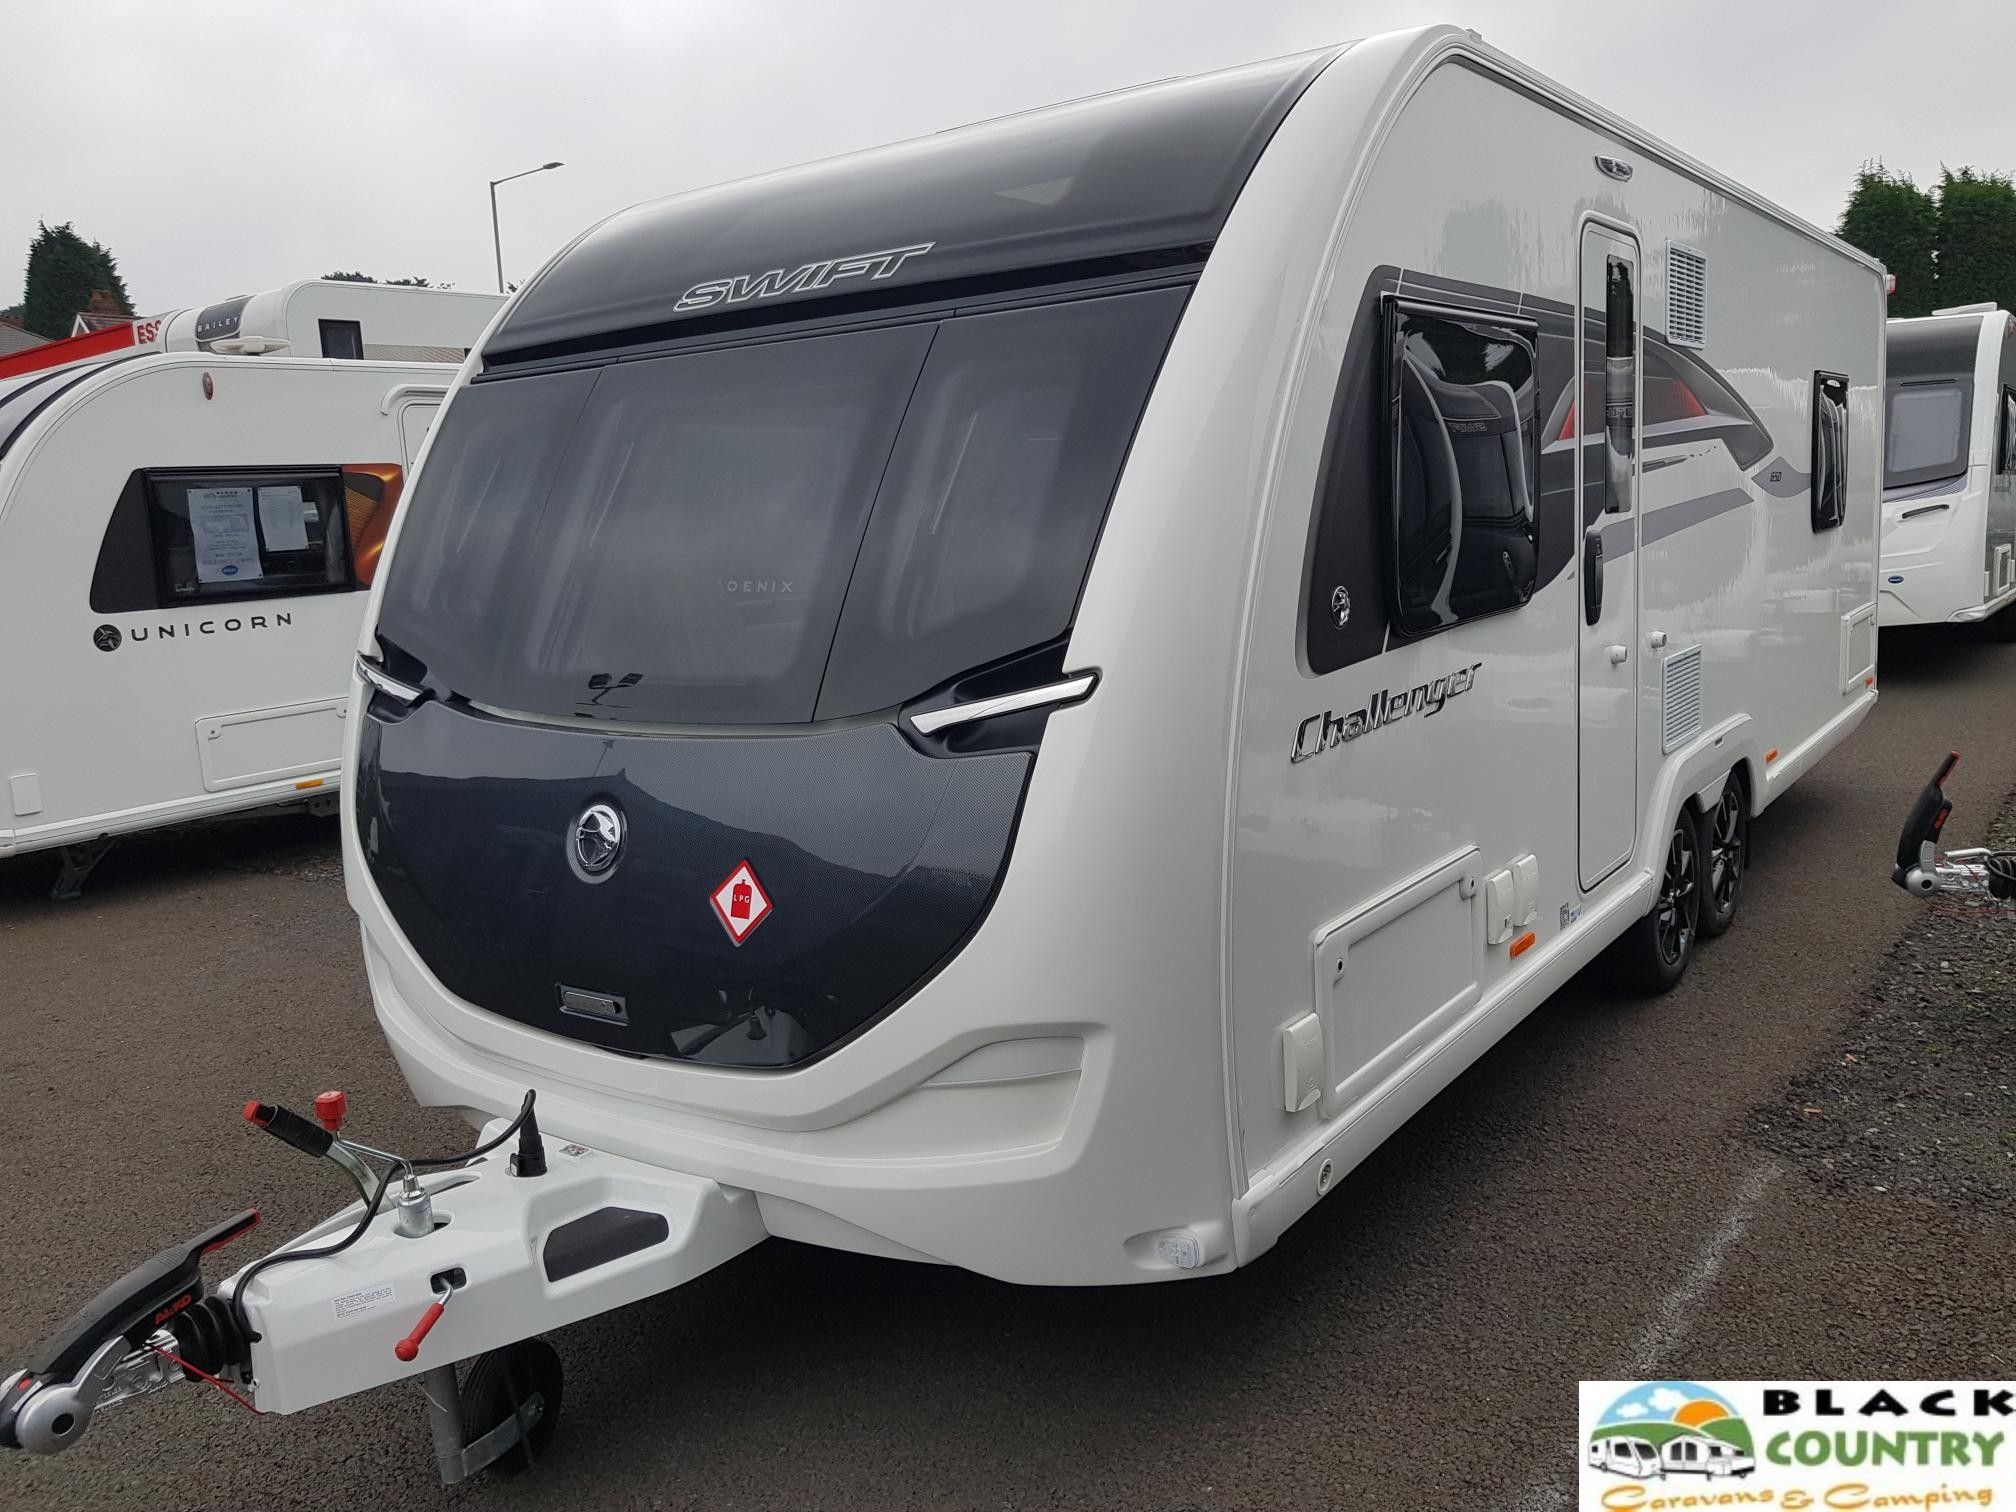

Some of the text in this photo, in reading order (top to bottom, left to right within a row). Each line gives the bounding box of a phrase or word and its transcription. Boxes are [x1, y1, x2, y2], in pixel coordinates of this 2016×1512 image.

[673, 241, 937, 312] SWIFT
[197, 316, 240, 333] BAILEY
[130, 613, 292, 642] UNICORN
[1290, 662, 1483, 764] Challenger
[733, 894, 751, 904] LPG
